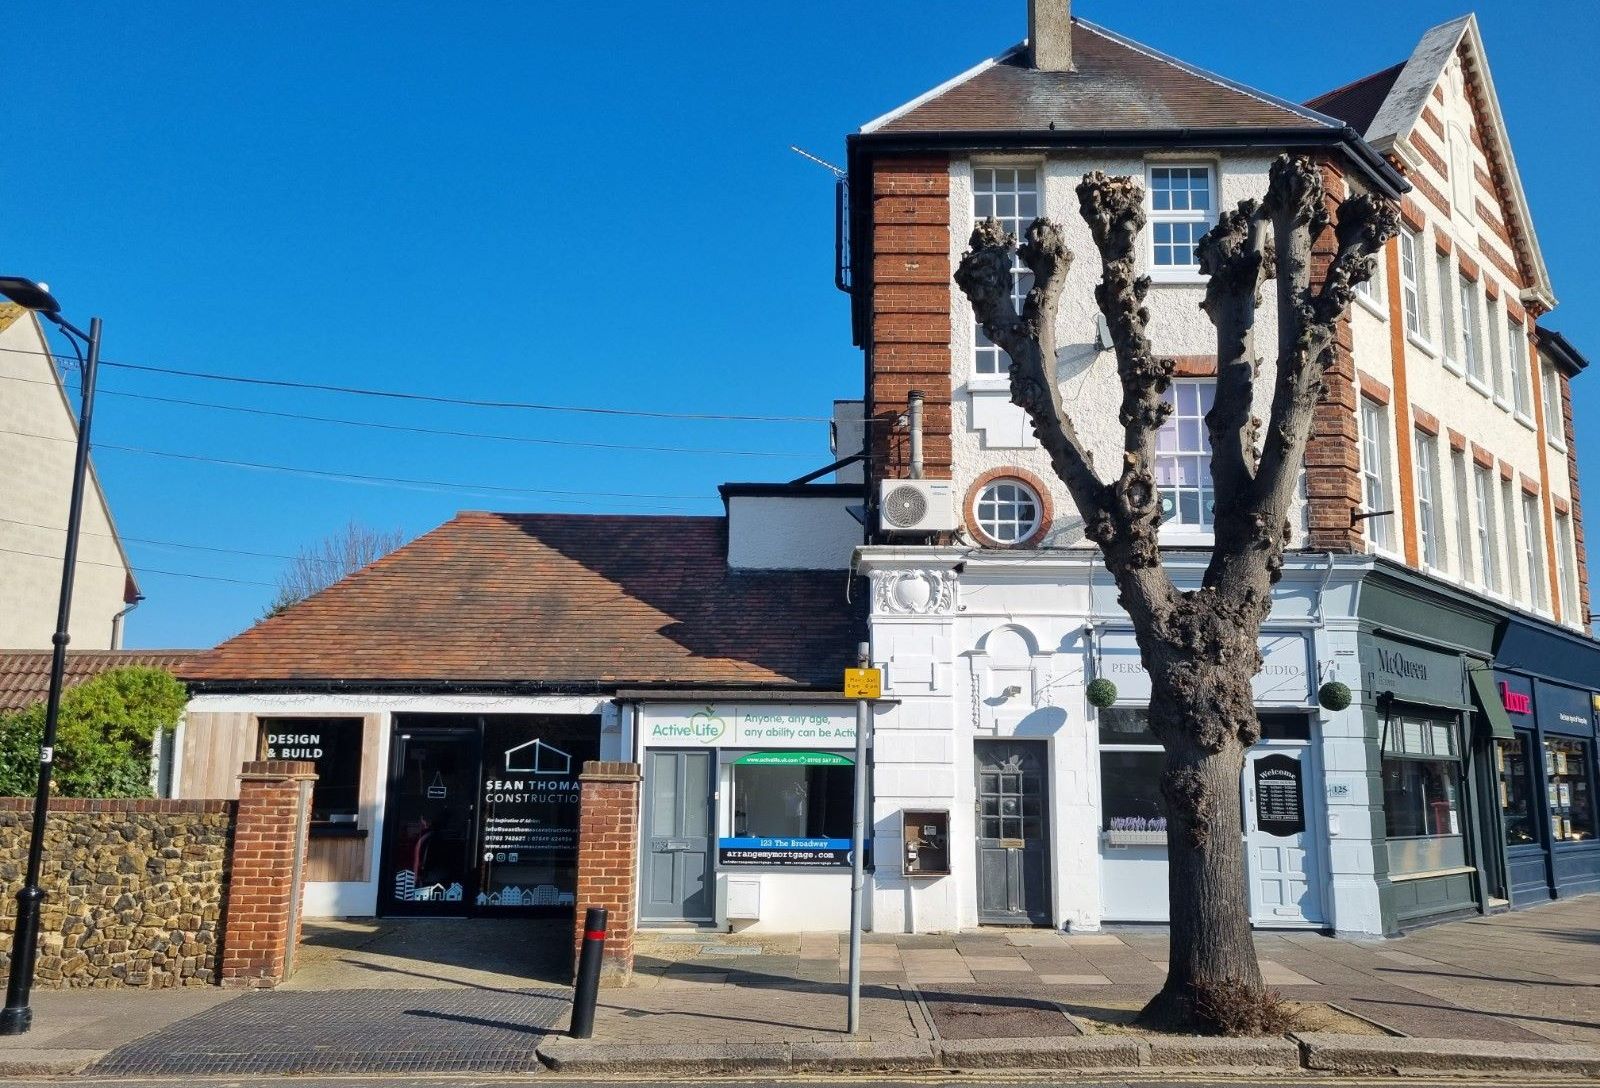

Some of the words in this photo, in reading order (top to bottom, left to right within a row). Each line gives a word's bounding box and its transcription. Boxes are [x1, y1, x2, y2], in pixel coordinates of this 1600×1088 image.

[1378, 648, 1427, 680] McQueen
[1259, 664, 1299, 676] UDIO
[744, 714, 785, 725] Anyone,
[788, 716, 806, 725] any
[809, 716, 831, 725] age,
[652, 724, 691, 737] Active
[695, 724, 719, 737] Life
[744, 729, 763, 738] any
[766, 728, 795, 739] ability
[798, 729, 816, 737] can
[819, 728, 831, 737] be
[268, 734, 320, 744] DESIGN
[267, 748, 276, 758] &
[282, 748, 323, 758] BUILD
[1259, 769, 1297, 779] Welcome
[486, 780, 524, 790] SEAN
[760, 839, 772, 847] 123
[775, 839, 789, 847] The
[791, 839, 828, 849] Broadway
[726, 850, 834, 859] arrangemymortgage.com
